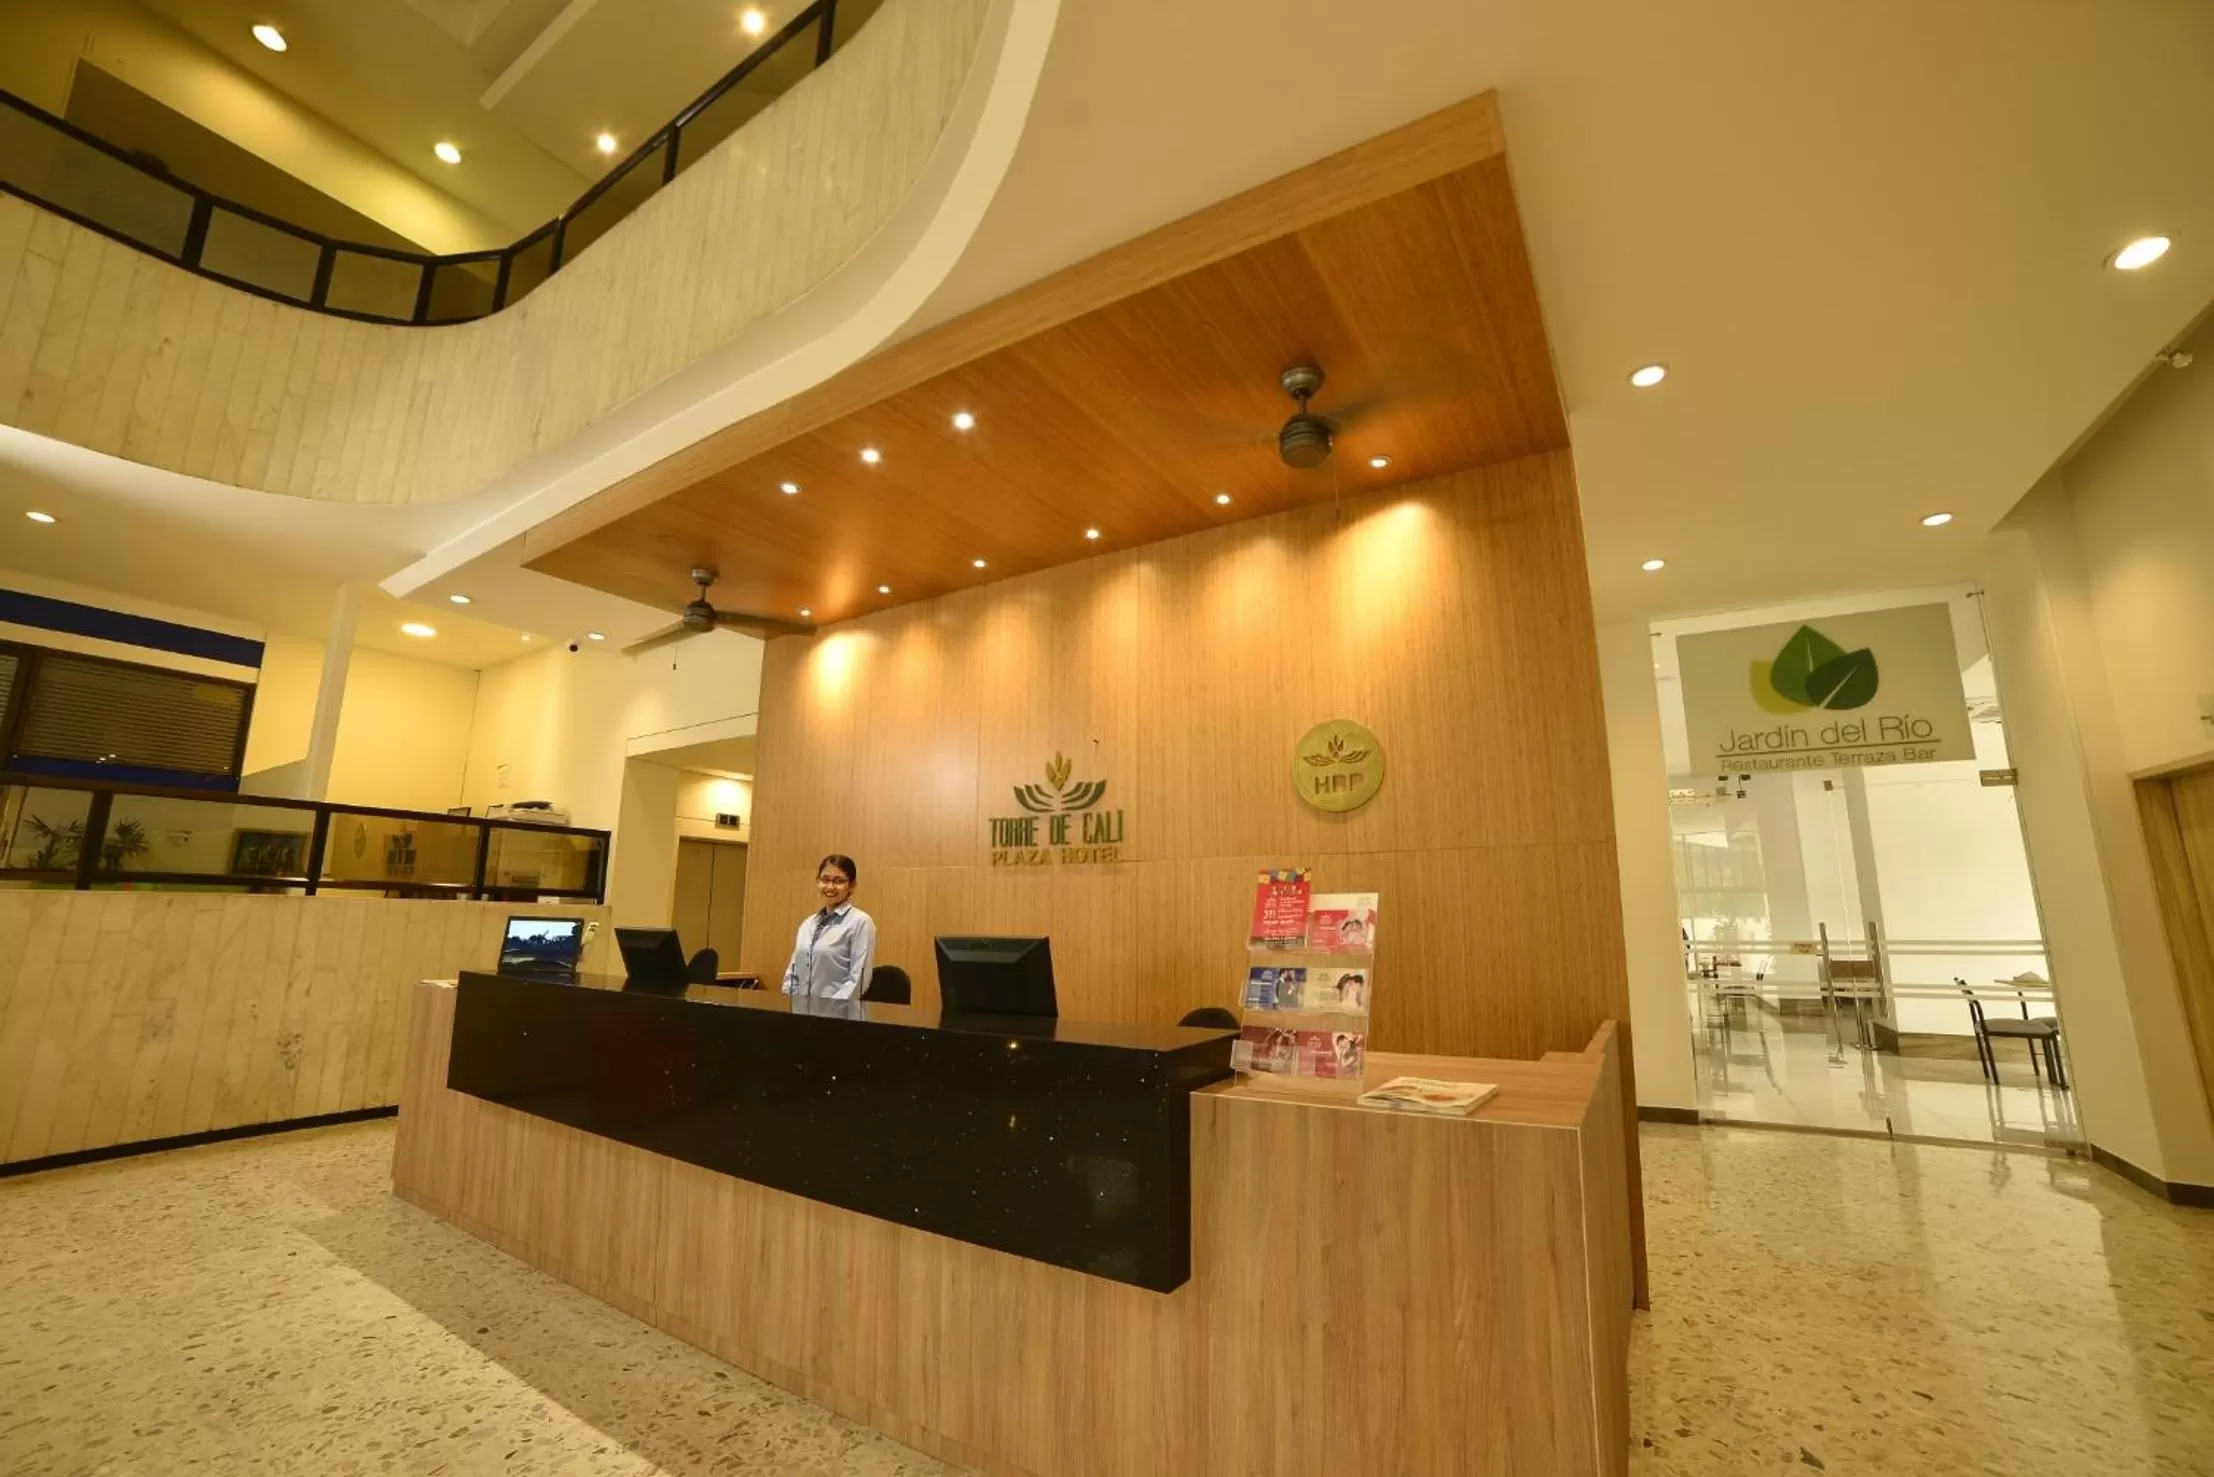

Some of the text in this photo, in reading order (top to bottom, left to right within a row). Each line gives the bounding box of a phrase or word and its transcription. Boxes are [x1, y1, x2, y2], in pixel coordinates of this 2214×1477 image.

[1820, 719, 1867, 745] del
[1879, 714, 1933, 741] Río
[1721, 747, 1936, 773] Restaurante Terraza Bar
[989, 810, 1125, 848] TORRE DE CALI
[992, 847, 1123, 868] PLAZA HOTEL
